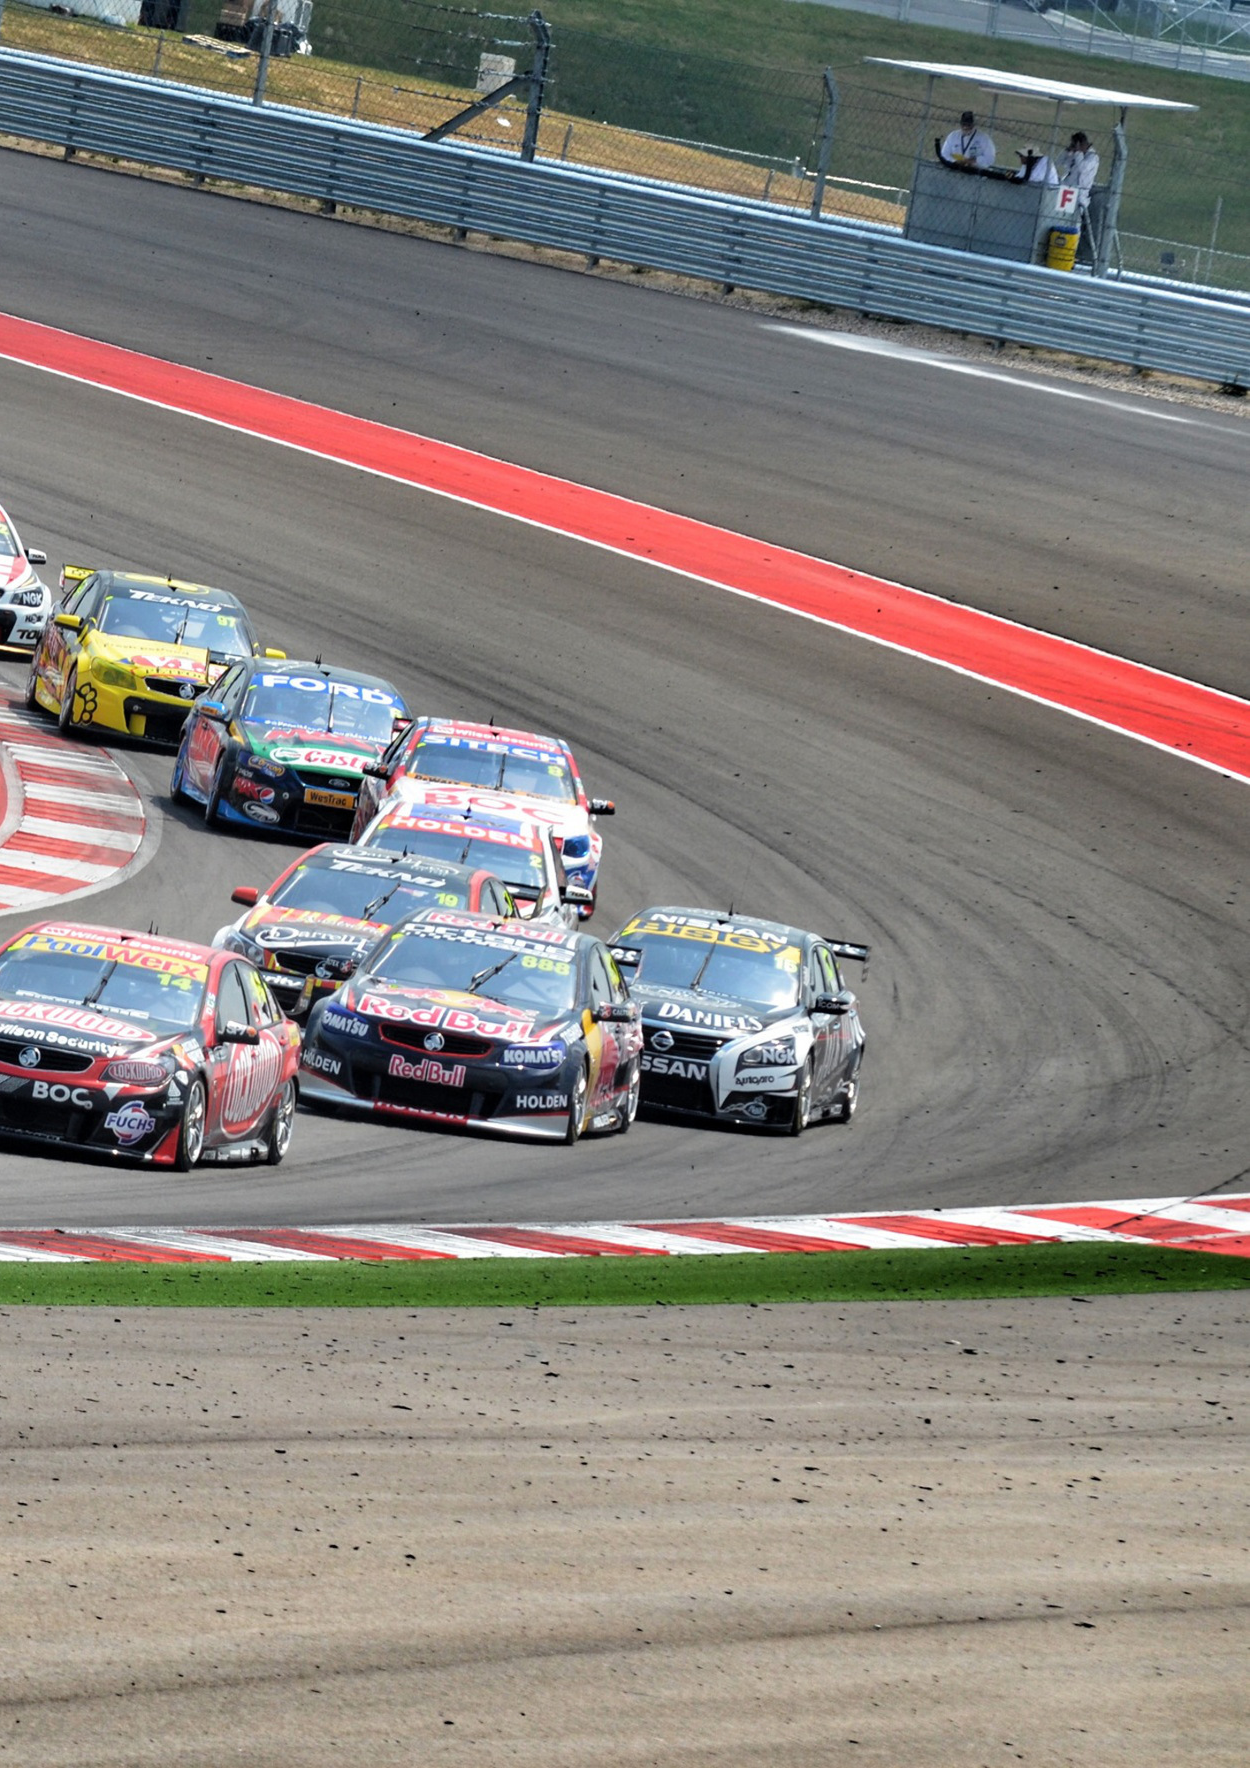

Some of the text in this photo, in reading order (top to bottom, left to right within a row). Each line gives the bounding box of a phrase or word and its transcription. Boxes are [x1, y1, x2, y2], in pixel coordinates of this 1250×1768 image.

[1060, 188, 1075, 209] F
[22, 592, 43, 607] NGK
[128, 588, 224, 613] TEKNO
[262, 674, 394, 705] FORD
[423, 734, 567, 767] SITECH
[309, 790, 348, 807] WesTrac
[390, 815, 534, 849] HOLDEN
[329, 859, 446, 888] TEKNO
[436, 892, 458, 908] 19
[650, 913, 788, 945] NISSAN
[521, 954, 571, 976] 888
[157, 973, 193, 991] 14
[302, 1049, 342, 1075] HOLDEN
[760, 1048, 797, 1066] NGK
[110, 1062, 163, 1081] LOCKWOOD
[640, 1056, 709, 1081] SSAN
[32, 1080, 91, 1106] BOC
[516, 1094, 568, 1109] HOLDEN
[106, 1114, 155, 1132] FUCHS
